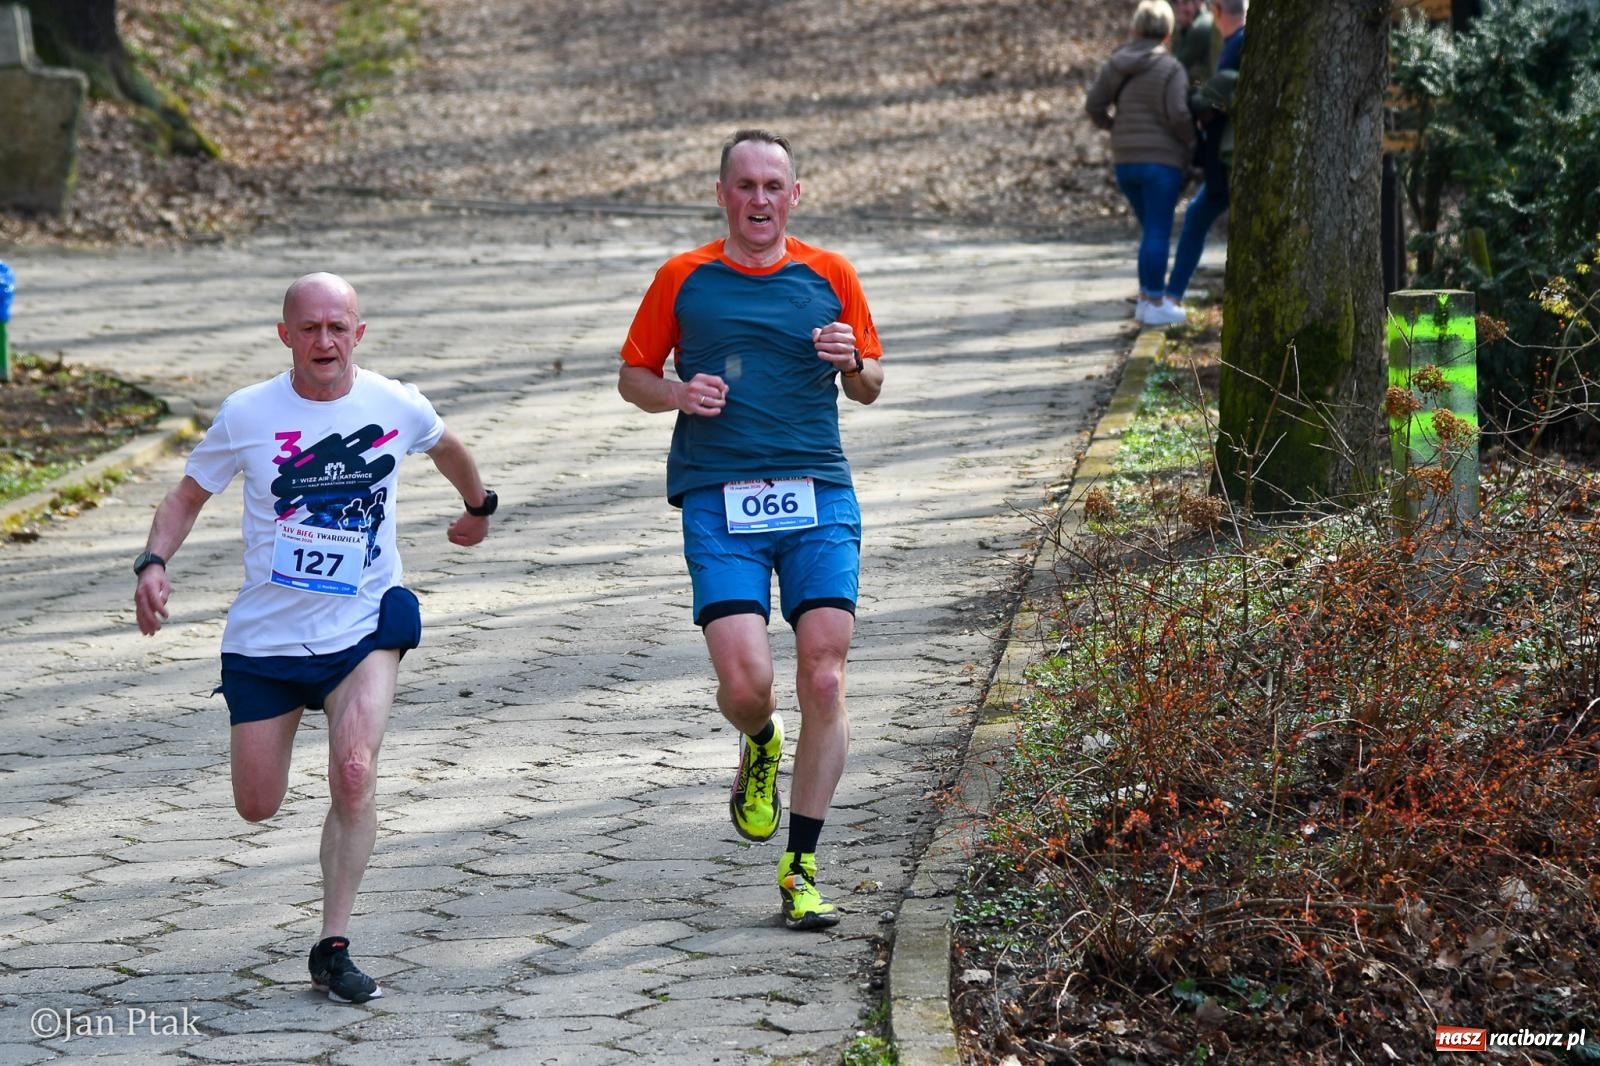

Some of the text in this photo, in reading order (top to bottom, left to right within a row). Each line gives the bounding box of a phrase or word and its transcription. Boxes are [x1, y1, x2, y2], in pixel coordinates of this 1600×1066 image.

[272, 431, 302, 465] 3
[340, 472, 373, 480] KATOWICE
[742, 492, 798, 517] 066
[283, 526, 295, 534] XIV
[296, 529, 314, 538] BIEG
[293, 548, 344, 577] 127
